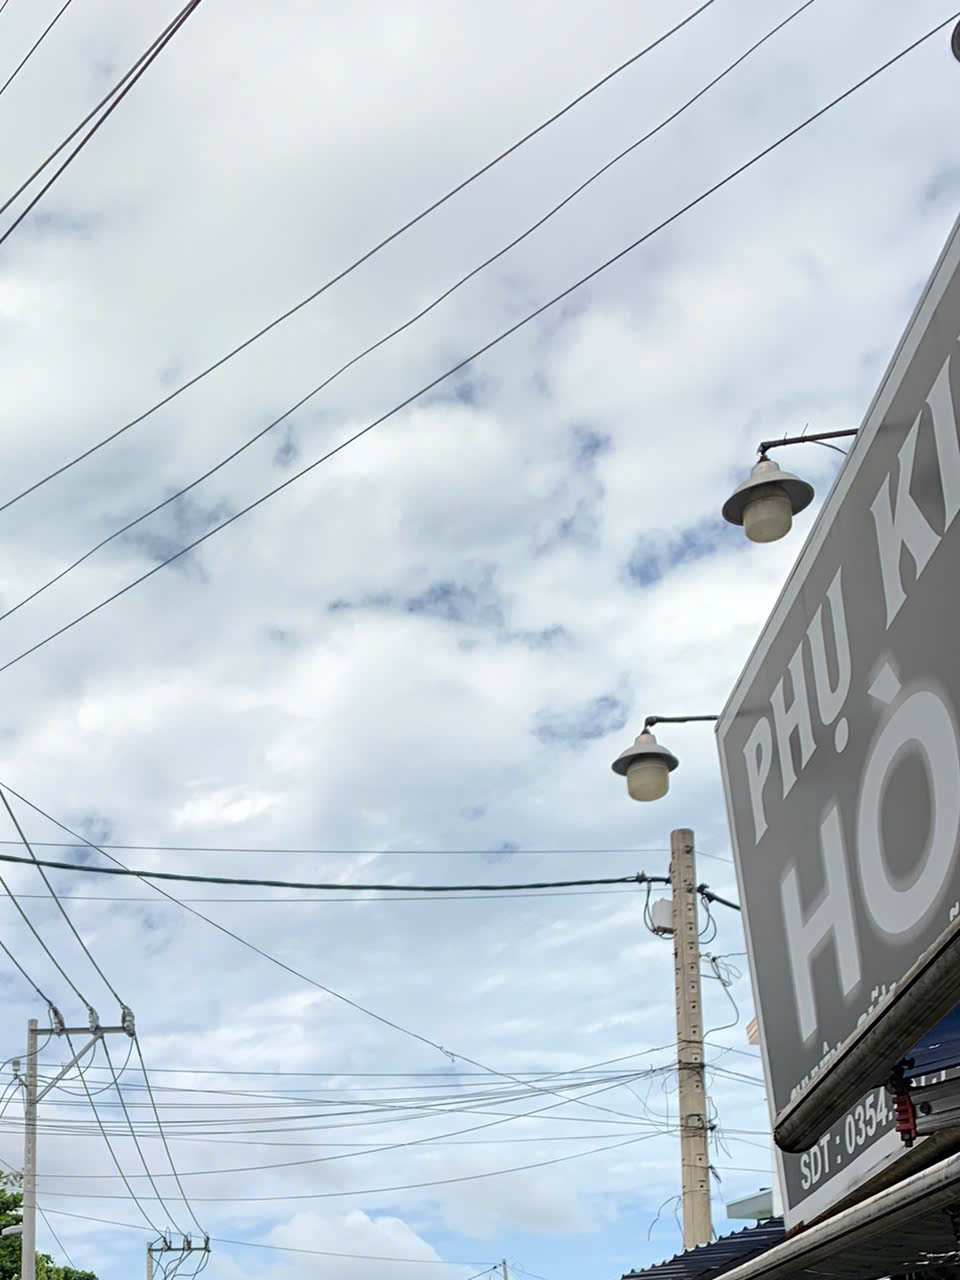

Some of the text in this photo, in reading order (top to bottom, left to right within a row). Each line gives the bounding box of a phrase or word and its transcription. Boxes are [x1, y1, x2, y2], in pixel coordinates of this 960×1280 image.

[742, 329, 960, 846] PHỤ KI
[844, 1085, 898, 1155] 0354.
